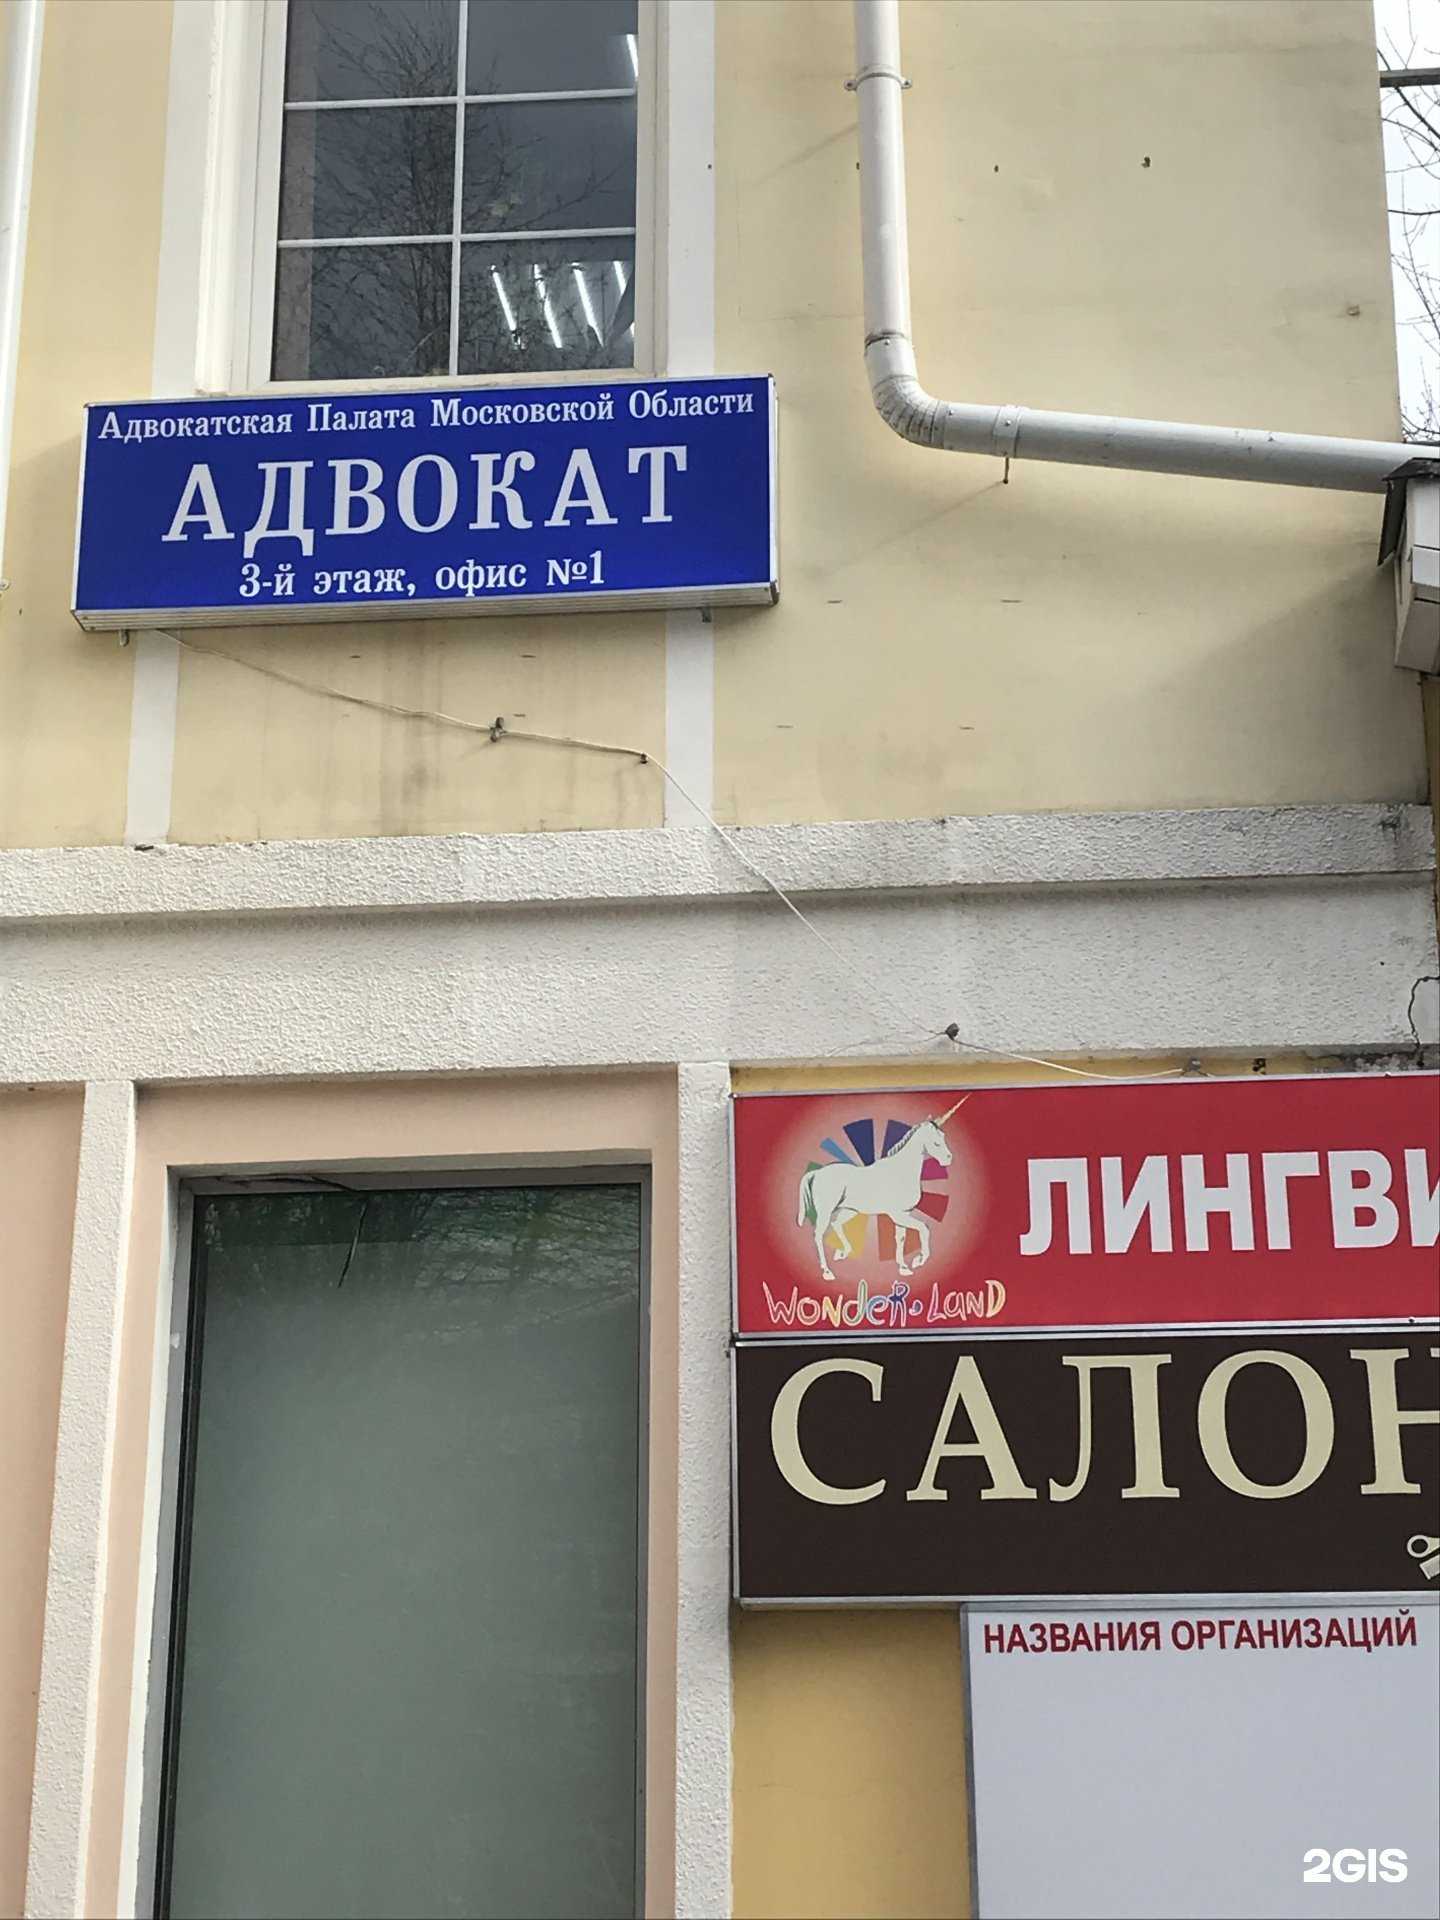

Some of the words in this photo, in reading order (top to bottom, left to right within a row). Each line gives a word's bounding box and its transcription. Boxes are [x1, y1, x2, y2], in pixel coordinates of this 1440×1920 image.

[98, 411, 293, 444] Адвокатская
[307, 403, 416, 432] Палата
[430, 391, 614, 427] Московской
[629, 389, 754, 418] Области
[162, 446, 687, 559] АДВОКАТ
[239, 563, 296, 598] 3-й
[313, 568, 416, 597] этаж,
[435, 557, 527, 598] офис
[547, 551, 605, 587] №1
[771, 1348, 1440, 1505] САЛОН
[983, 1621, 1161, 1654] НАЗВАНИЯ
[1171, 1608, 1417, 1653] ОРГАНИЗАЦИЙ
